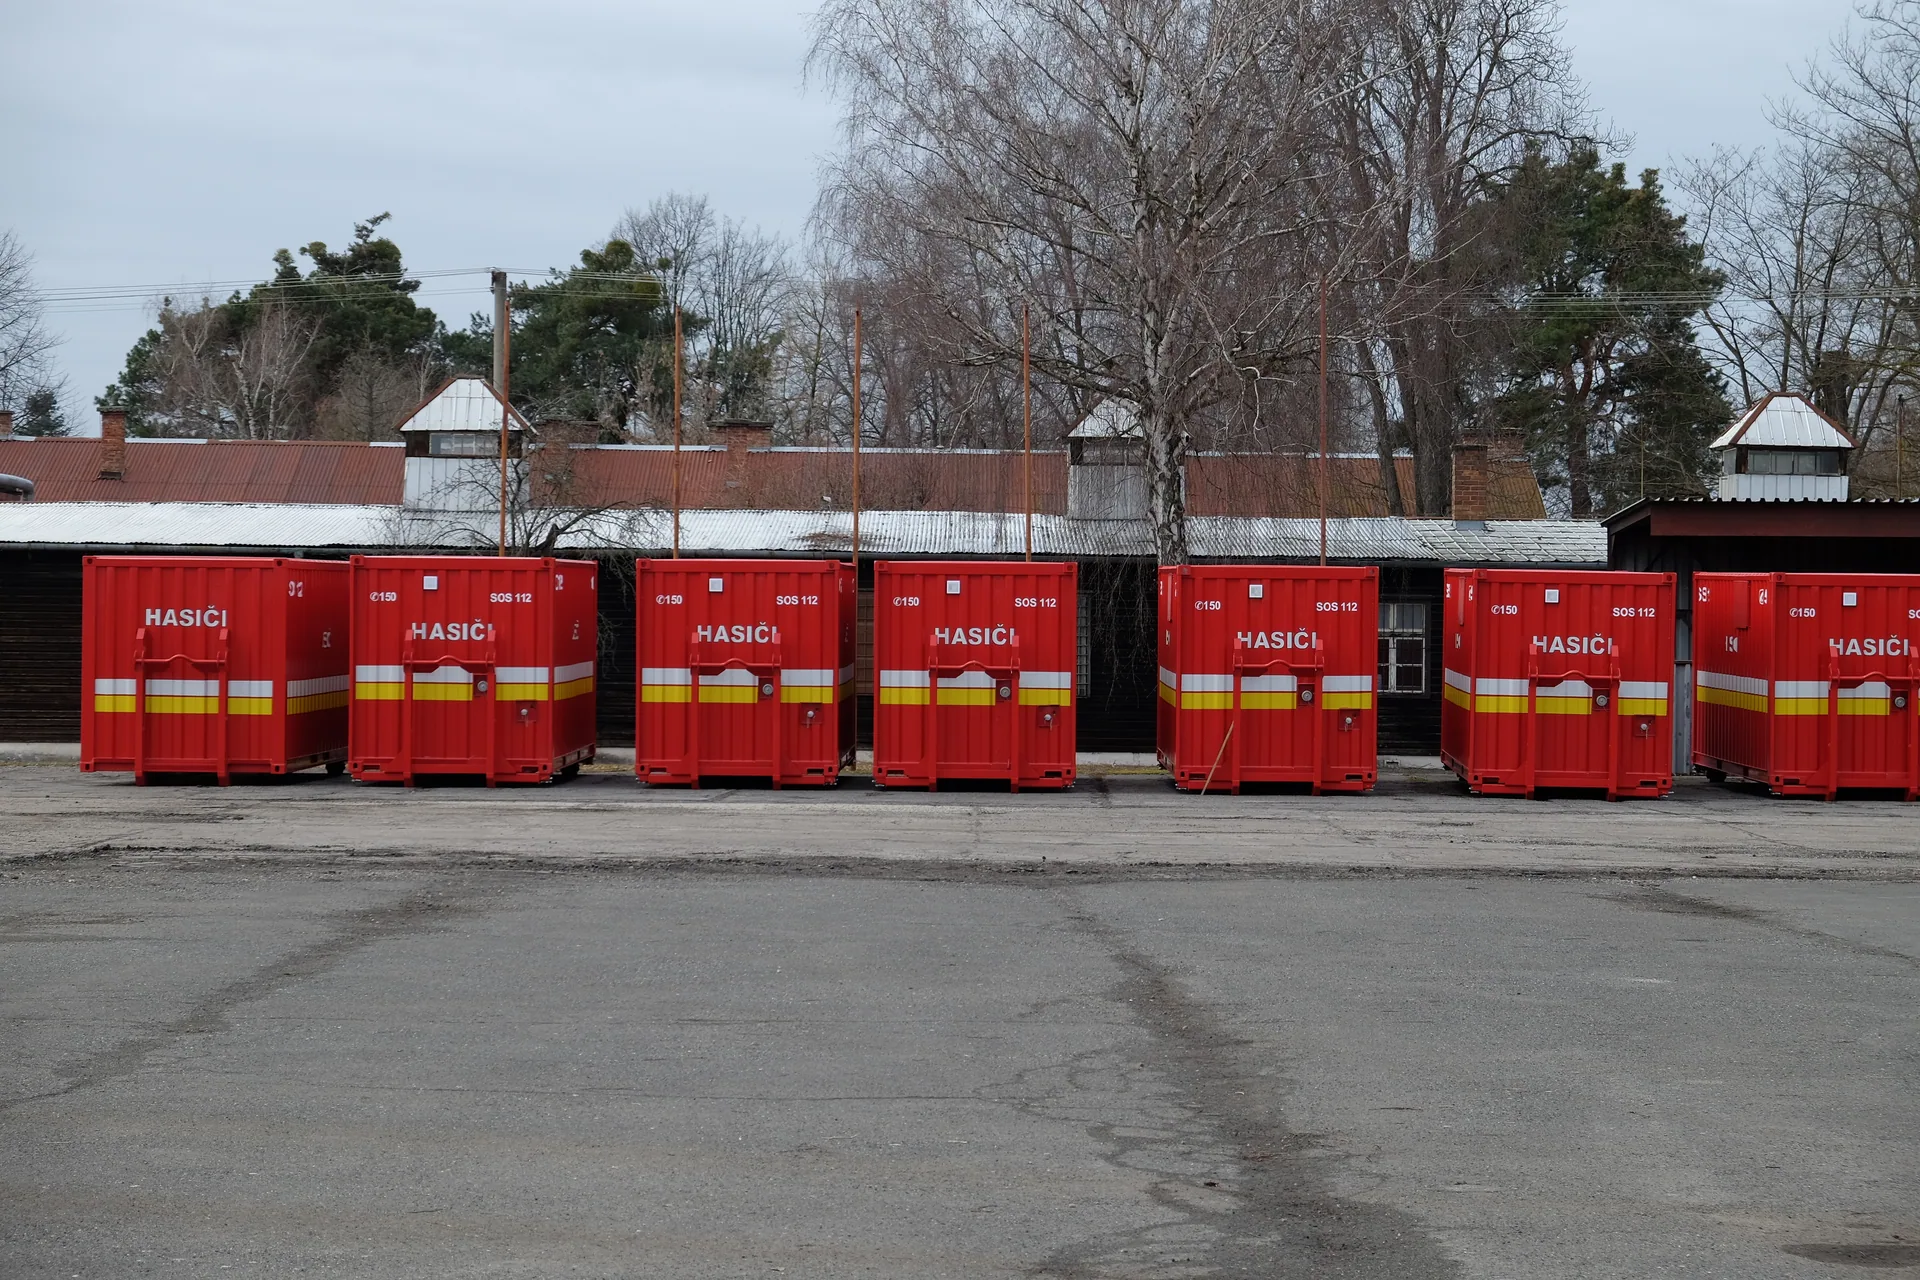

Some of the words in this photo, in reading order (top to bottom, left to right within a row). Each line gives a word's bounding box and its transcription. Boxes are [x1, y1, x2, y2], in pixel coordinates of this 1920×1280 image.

[378, 591, 397, 602] 150
[489, 592, 513, 603] SOS
[514, 592, 532, 603] 112
[664, 594, 683, 605] 150
[776, 595, 799, 606] SOS
[800, 595, 819, 606] 112
[901, 596, 919, 607] 150
[1014, 597, 1038, 608] SOS
[1039, 597, 1057, 608] 112
[1203, 600, 1221, 611] 150
[1315, 601, 1339, 612] SOS
[1340, 601, 1358, 612] 112
[1499, 604, 1517, 615] 150
[1612, 607, 1636, 618] SOS
[1637, 607, 1656, 618] 112
[1798, 607, 1815, 618] 150
[145, 605, 227, 627] HASIČI
[697, 621, 778, 644] HASIČI
[934, 623, 1016, 646] HASIČI
[1237, 627, 1318, 649] HASIČI
[1532, 632, 1613, 655] HASIČI
[1829, 634, 1909, 656] HASIČI
